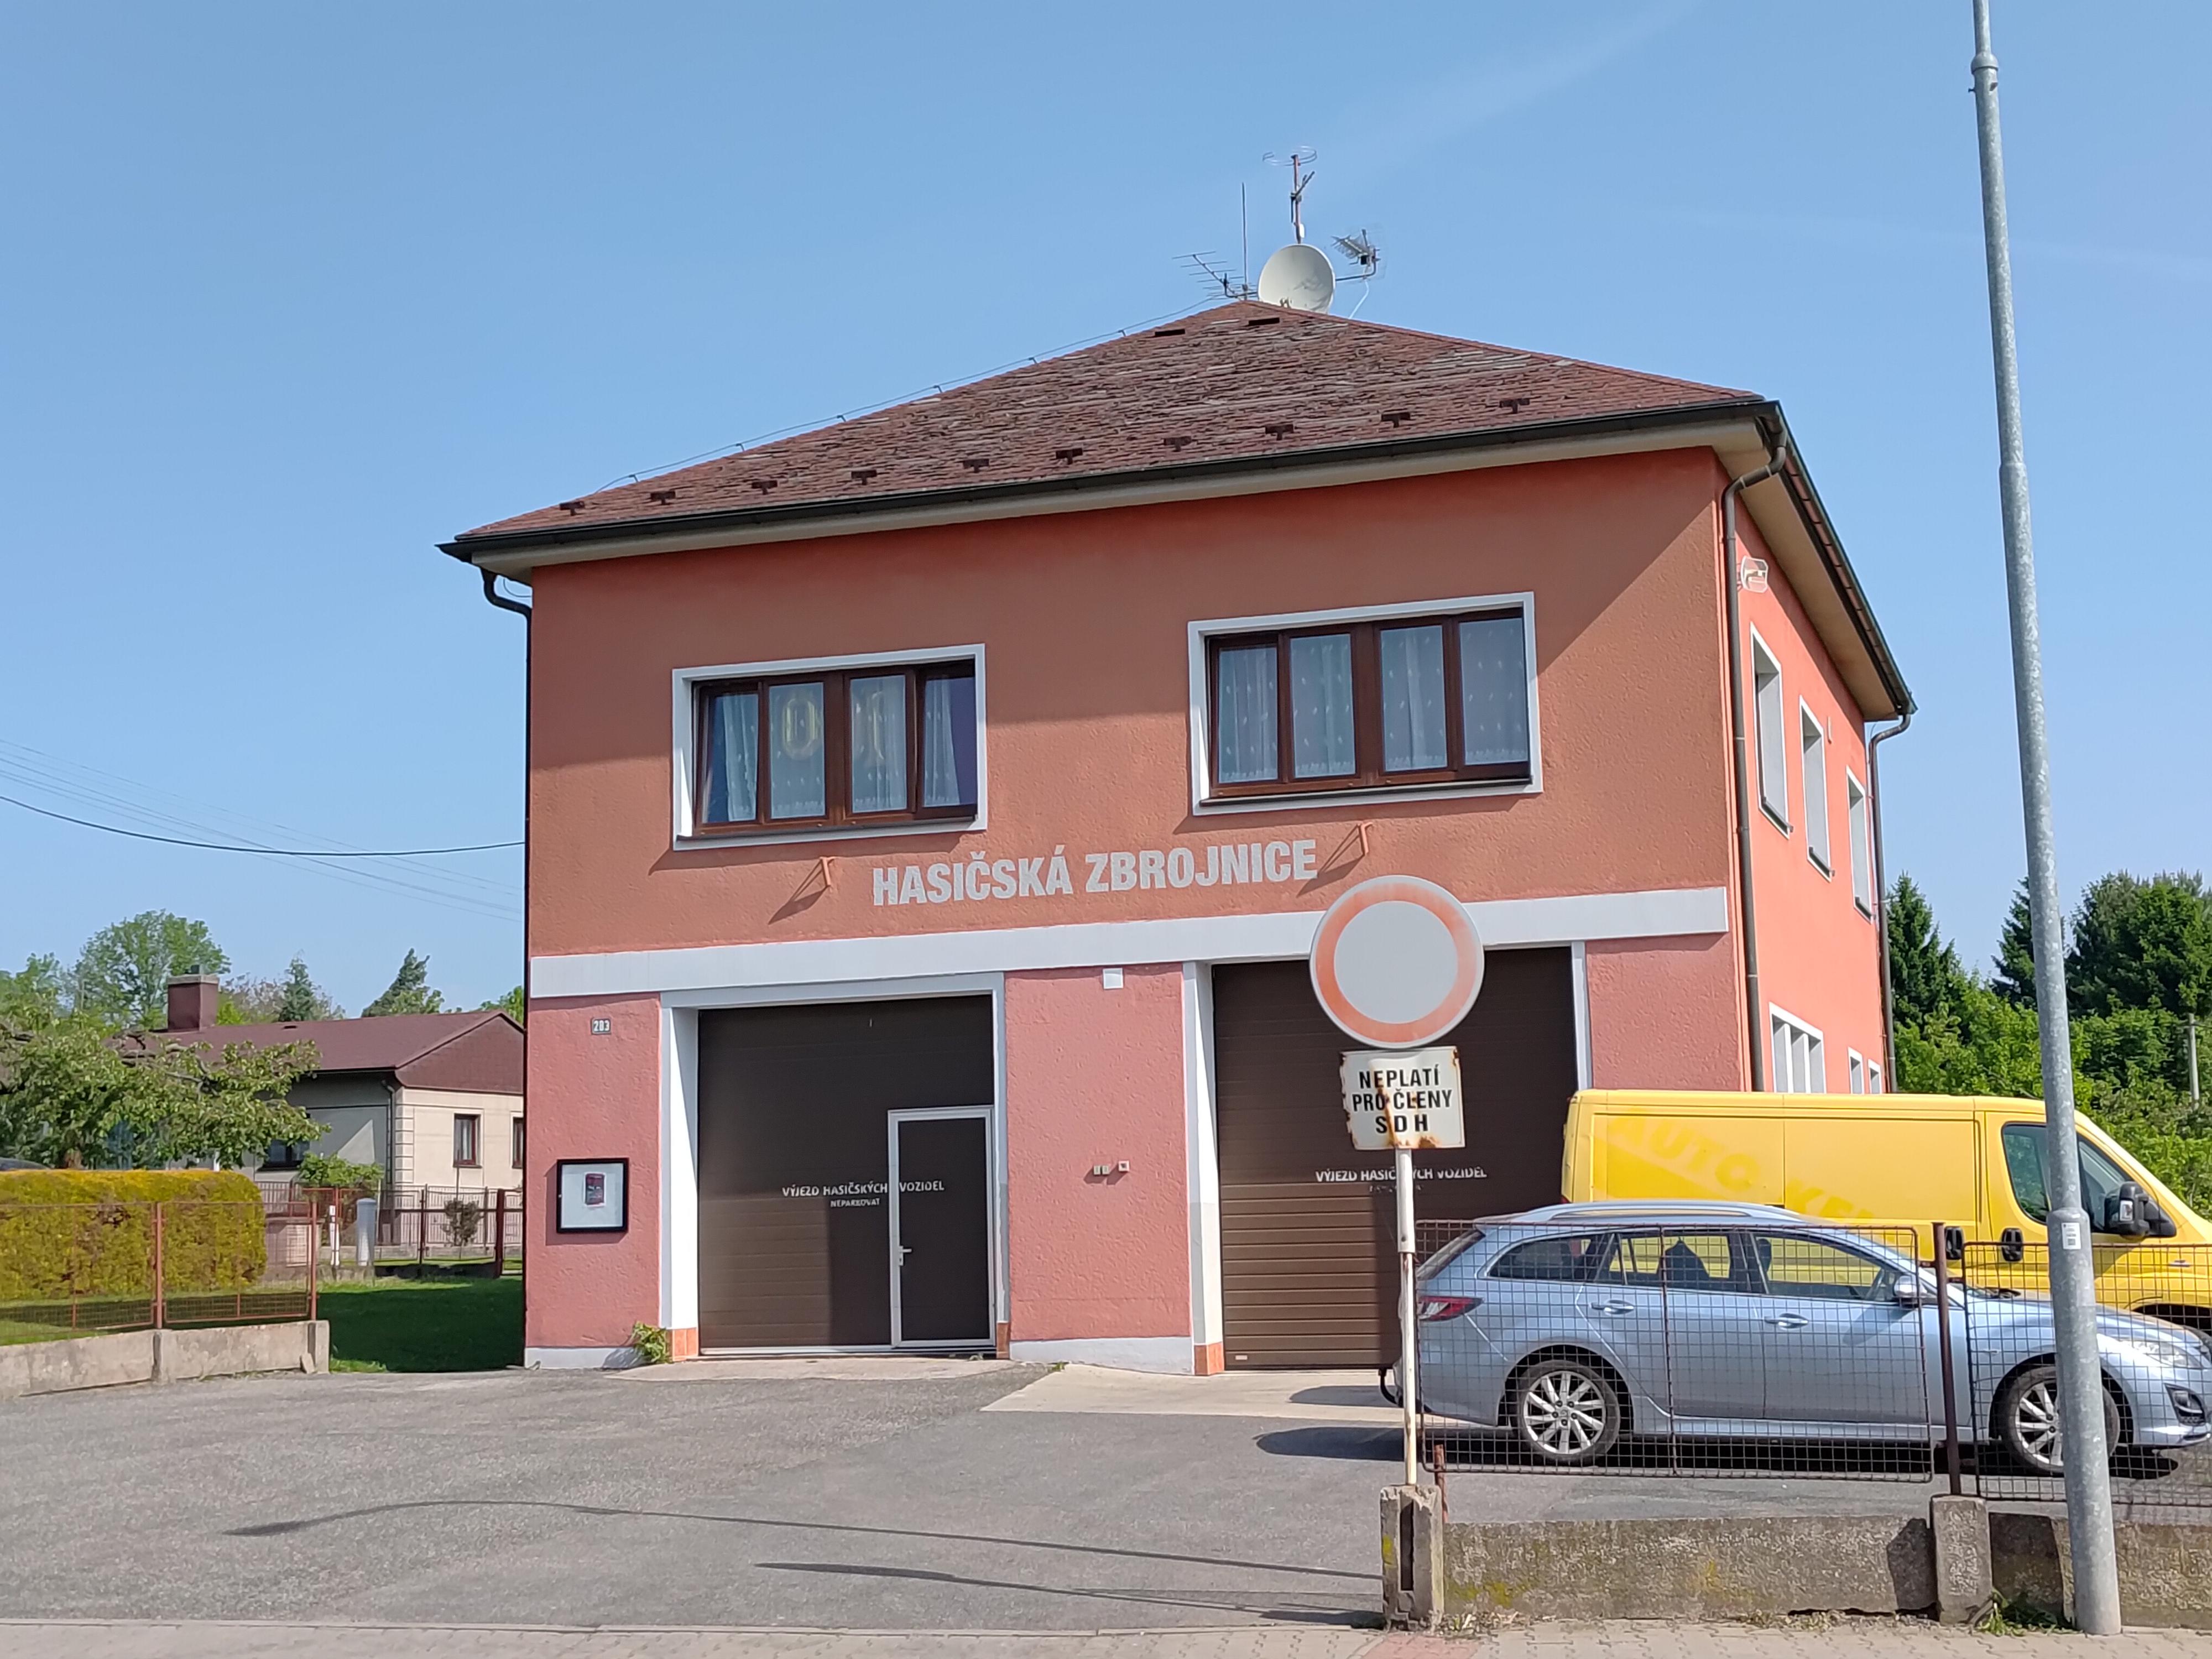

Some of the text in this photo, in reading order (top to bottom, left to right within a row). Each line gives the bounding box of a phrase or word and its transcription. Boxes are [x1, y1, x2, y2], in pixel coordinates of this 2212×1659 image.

[872, 839, 1318, 906] HASIČSKÁ ZBROJNICE
[593, 1020, 609, 1032] 203
[1359, 1064, 1439, 1089] NEPLATÍ
[1352, 1088, 1452, 1112] PRO ČLENY
[1316, 1167, 1357, 1182] VÝJEZD
[782, 1180, 945, 1197] VÝJEZD HASIČSKÝCH VOZIDEL
[830, 1198, 880, 1208] NEPARKOVAT
